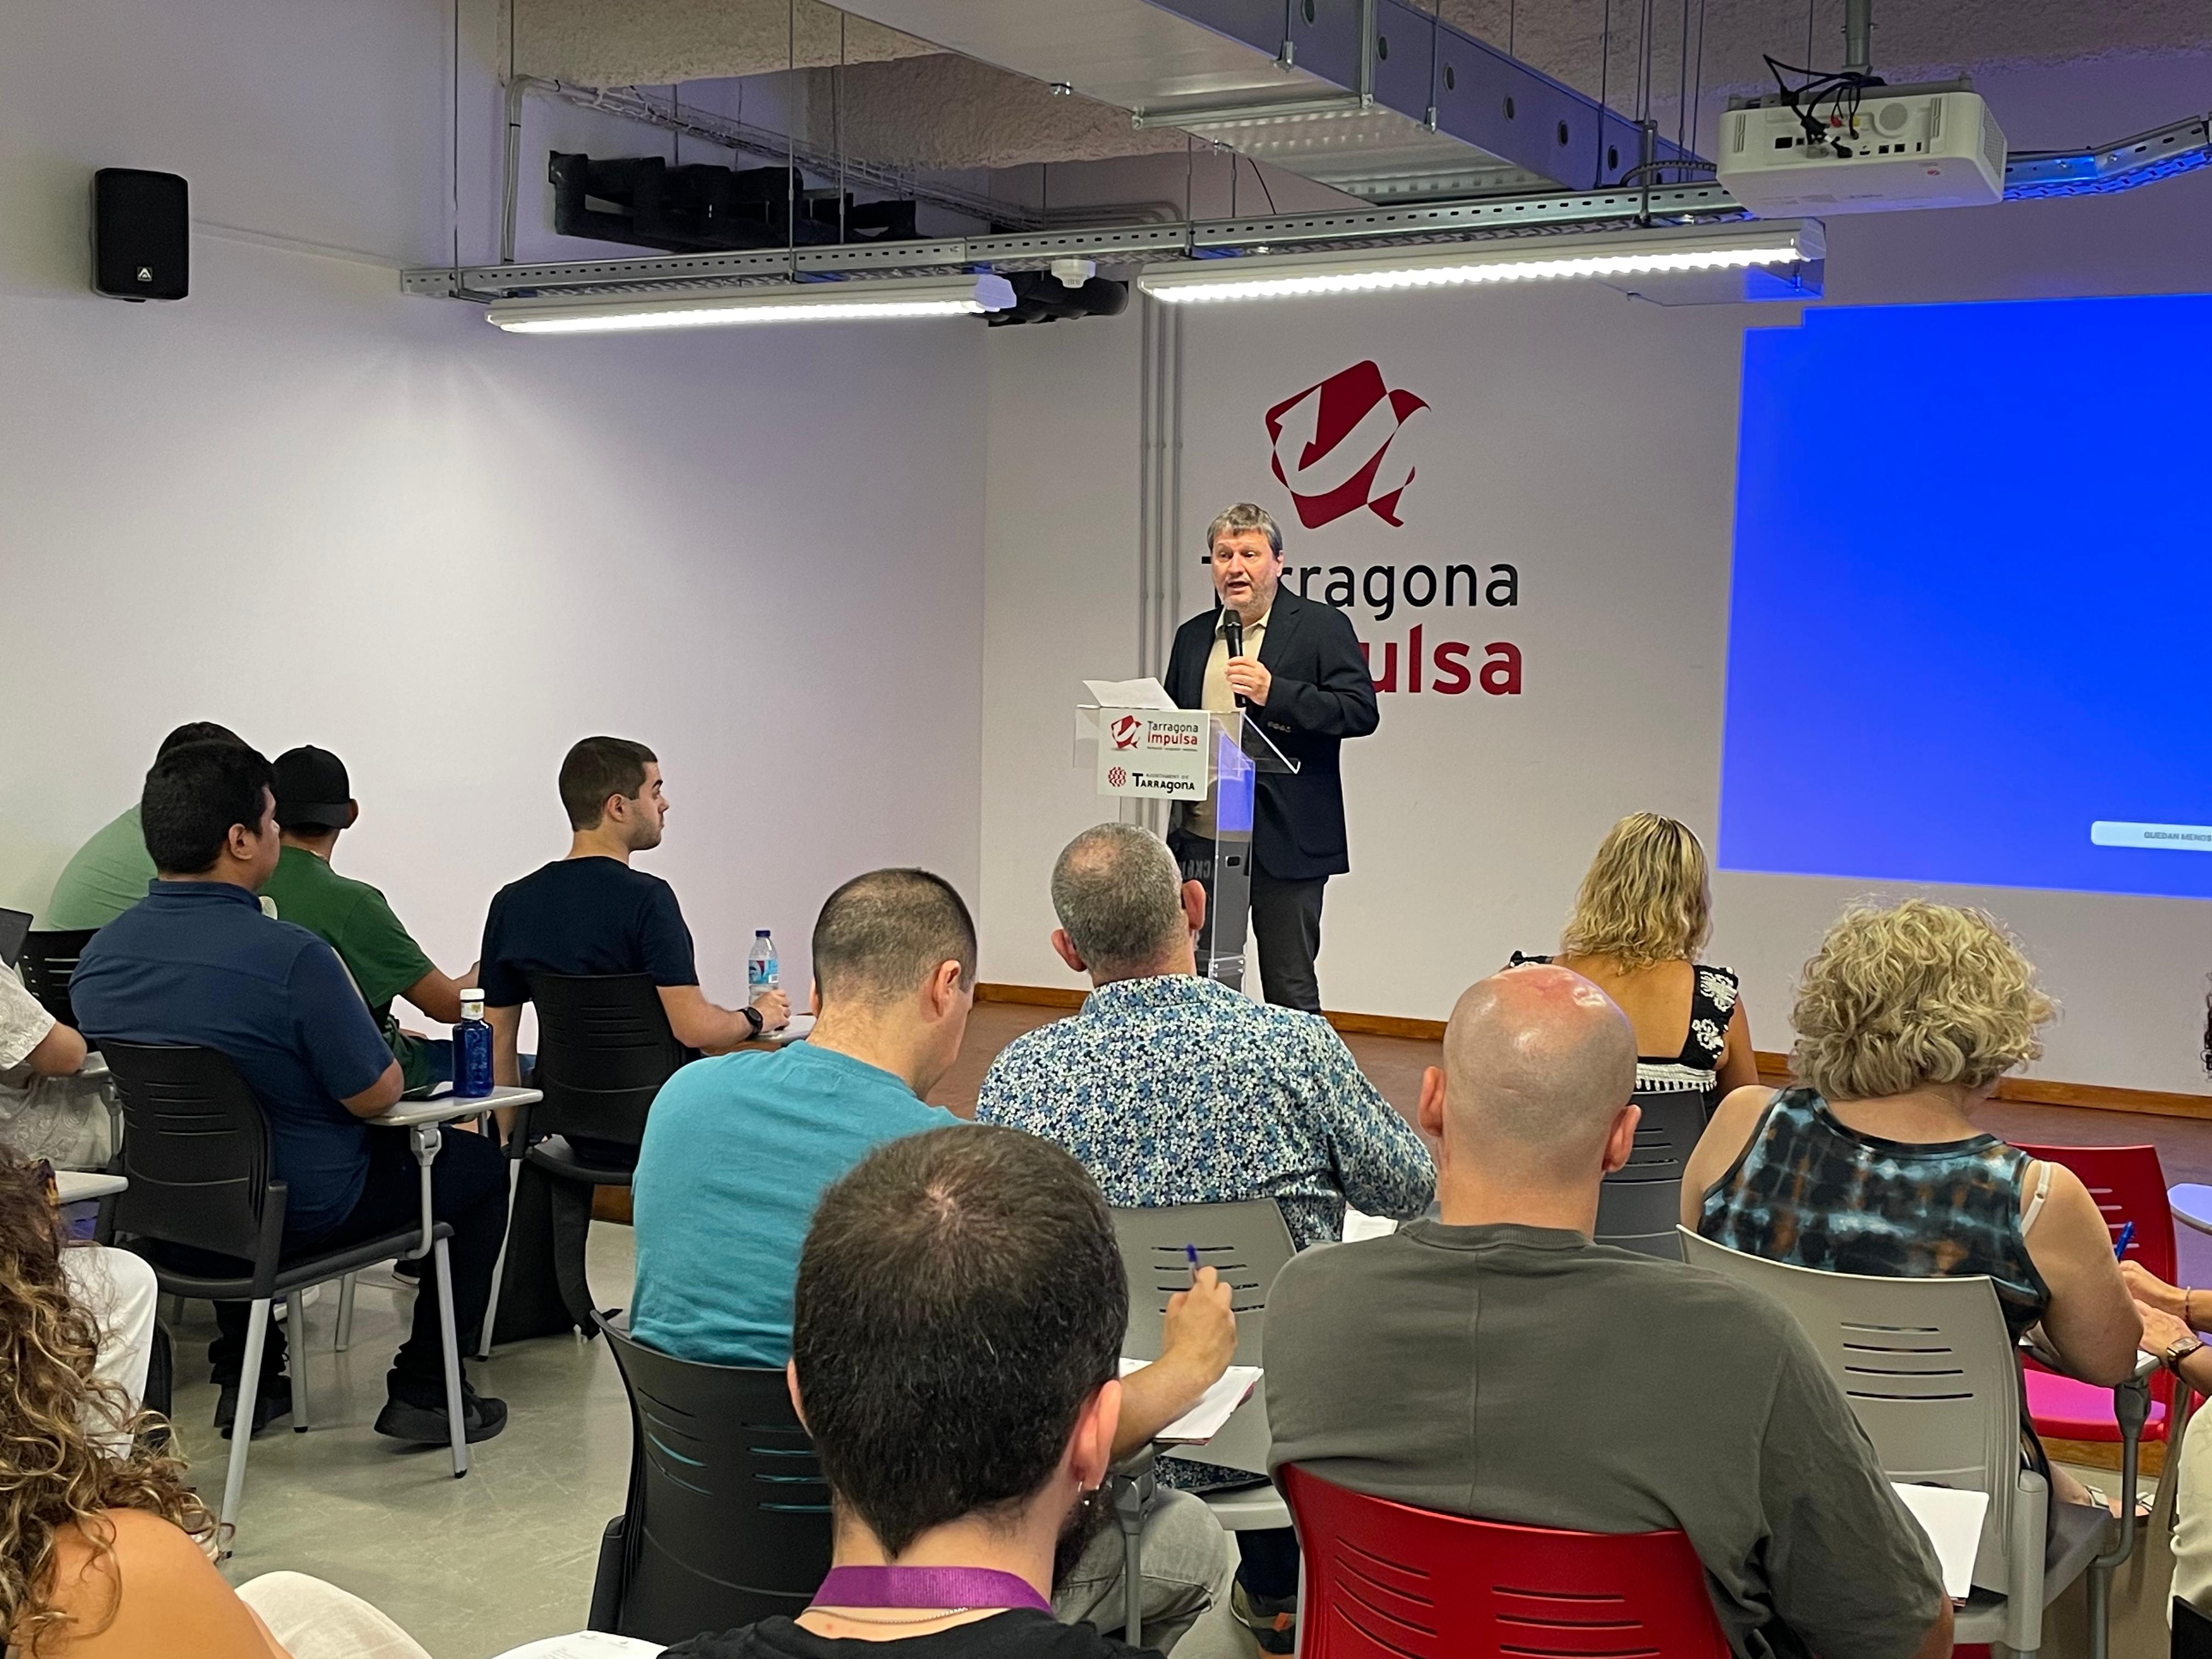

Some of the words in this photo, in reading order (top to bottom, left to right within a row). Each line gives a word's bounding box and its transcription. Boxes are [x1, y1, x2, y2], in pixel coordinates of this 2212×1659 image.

[1147, 721, 1198, 733] Tarragona
[2144, 831, 2179, 839] QUEDAN
[2181, 833, 2211, 842] MENOS
